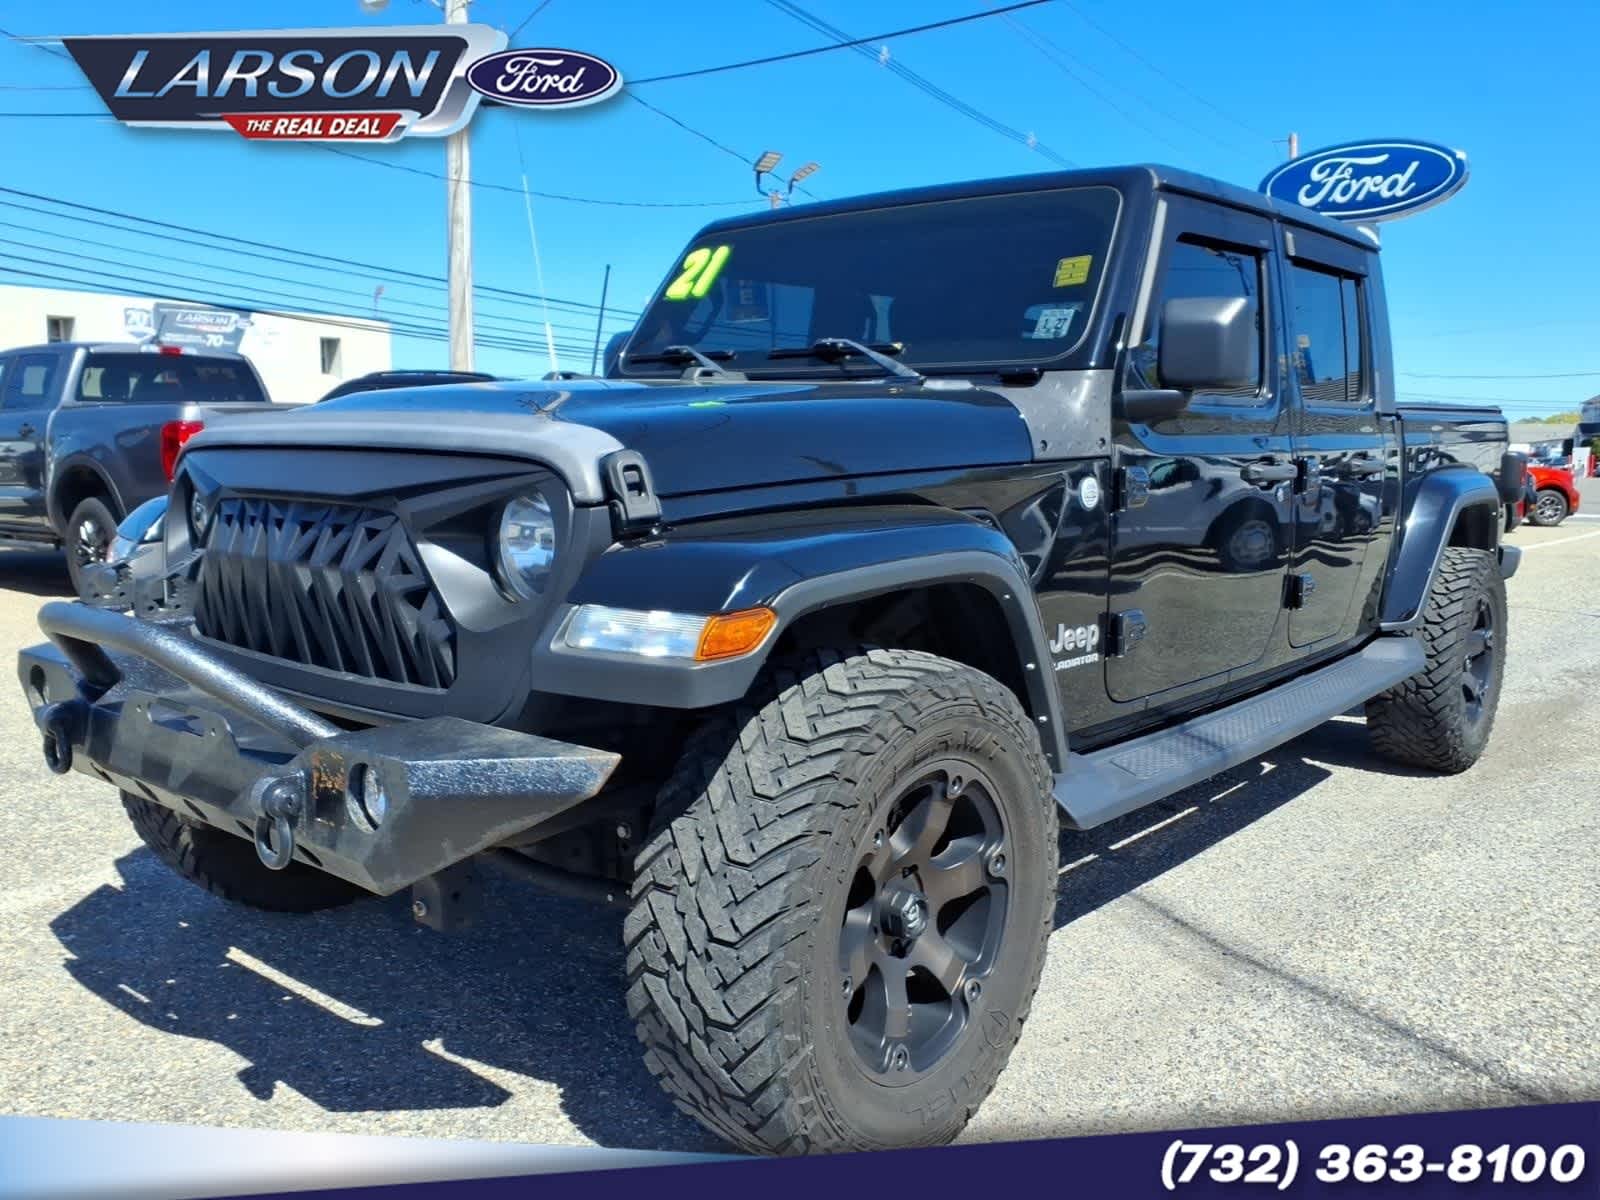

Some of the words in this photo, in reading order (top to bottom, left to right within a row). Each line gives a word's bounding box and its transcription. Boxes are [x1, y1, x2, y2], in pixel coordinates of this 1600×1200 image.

[1298, 153, 1420, 207] Ford
[665, 245, 731, 300] 21
[1049, 623, 1100, 654] Jeep
